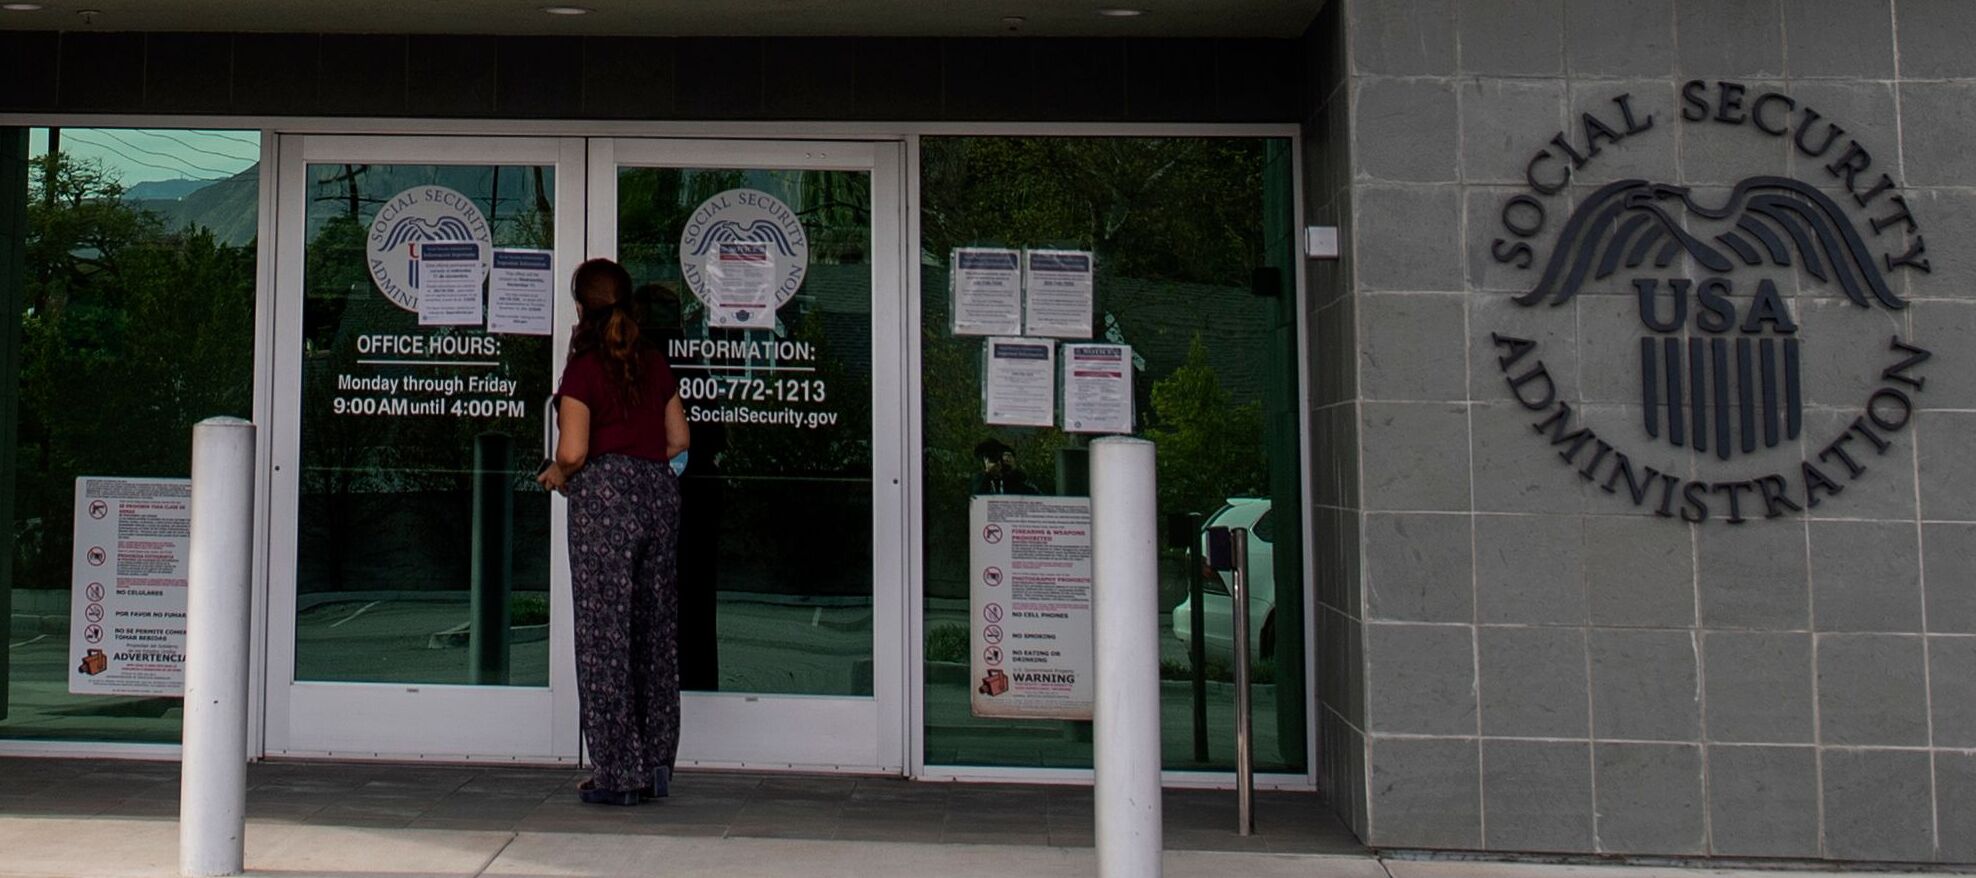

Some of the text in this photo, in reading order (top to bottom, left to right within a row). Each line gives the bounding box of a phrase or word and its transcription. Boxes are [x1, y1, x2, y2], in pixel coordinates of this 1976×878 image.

[1491, 79, 1931, 274] SOCIAL SECURITY
[371, 188, 489, 243] SOCIAL SECURITY
[684, 192, 805, 247] SOCIAL SECURITY
[1633, 279, 1799, 333] USA
[357, 335, 502, 356] OFFICE HOURS:
[668, 339, 816, 361] INFORMATION:
[338, 374, 517, 397] Monday through Friday
[679, 377, 825, 403] 800-772-1213
[333, 397, 525, 418] 9:00 AM until 4:00 PM
[683, 406, 838, 429] .SocialSecurity.gov
[1491, 331, 1933, 524] ADMINISTRATION
[1012, 673, 1075, 684] WARNING
